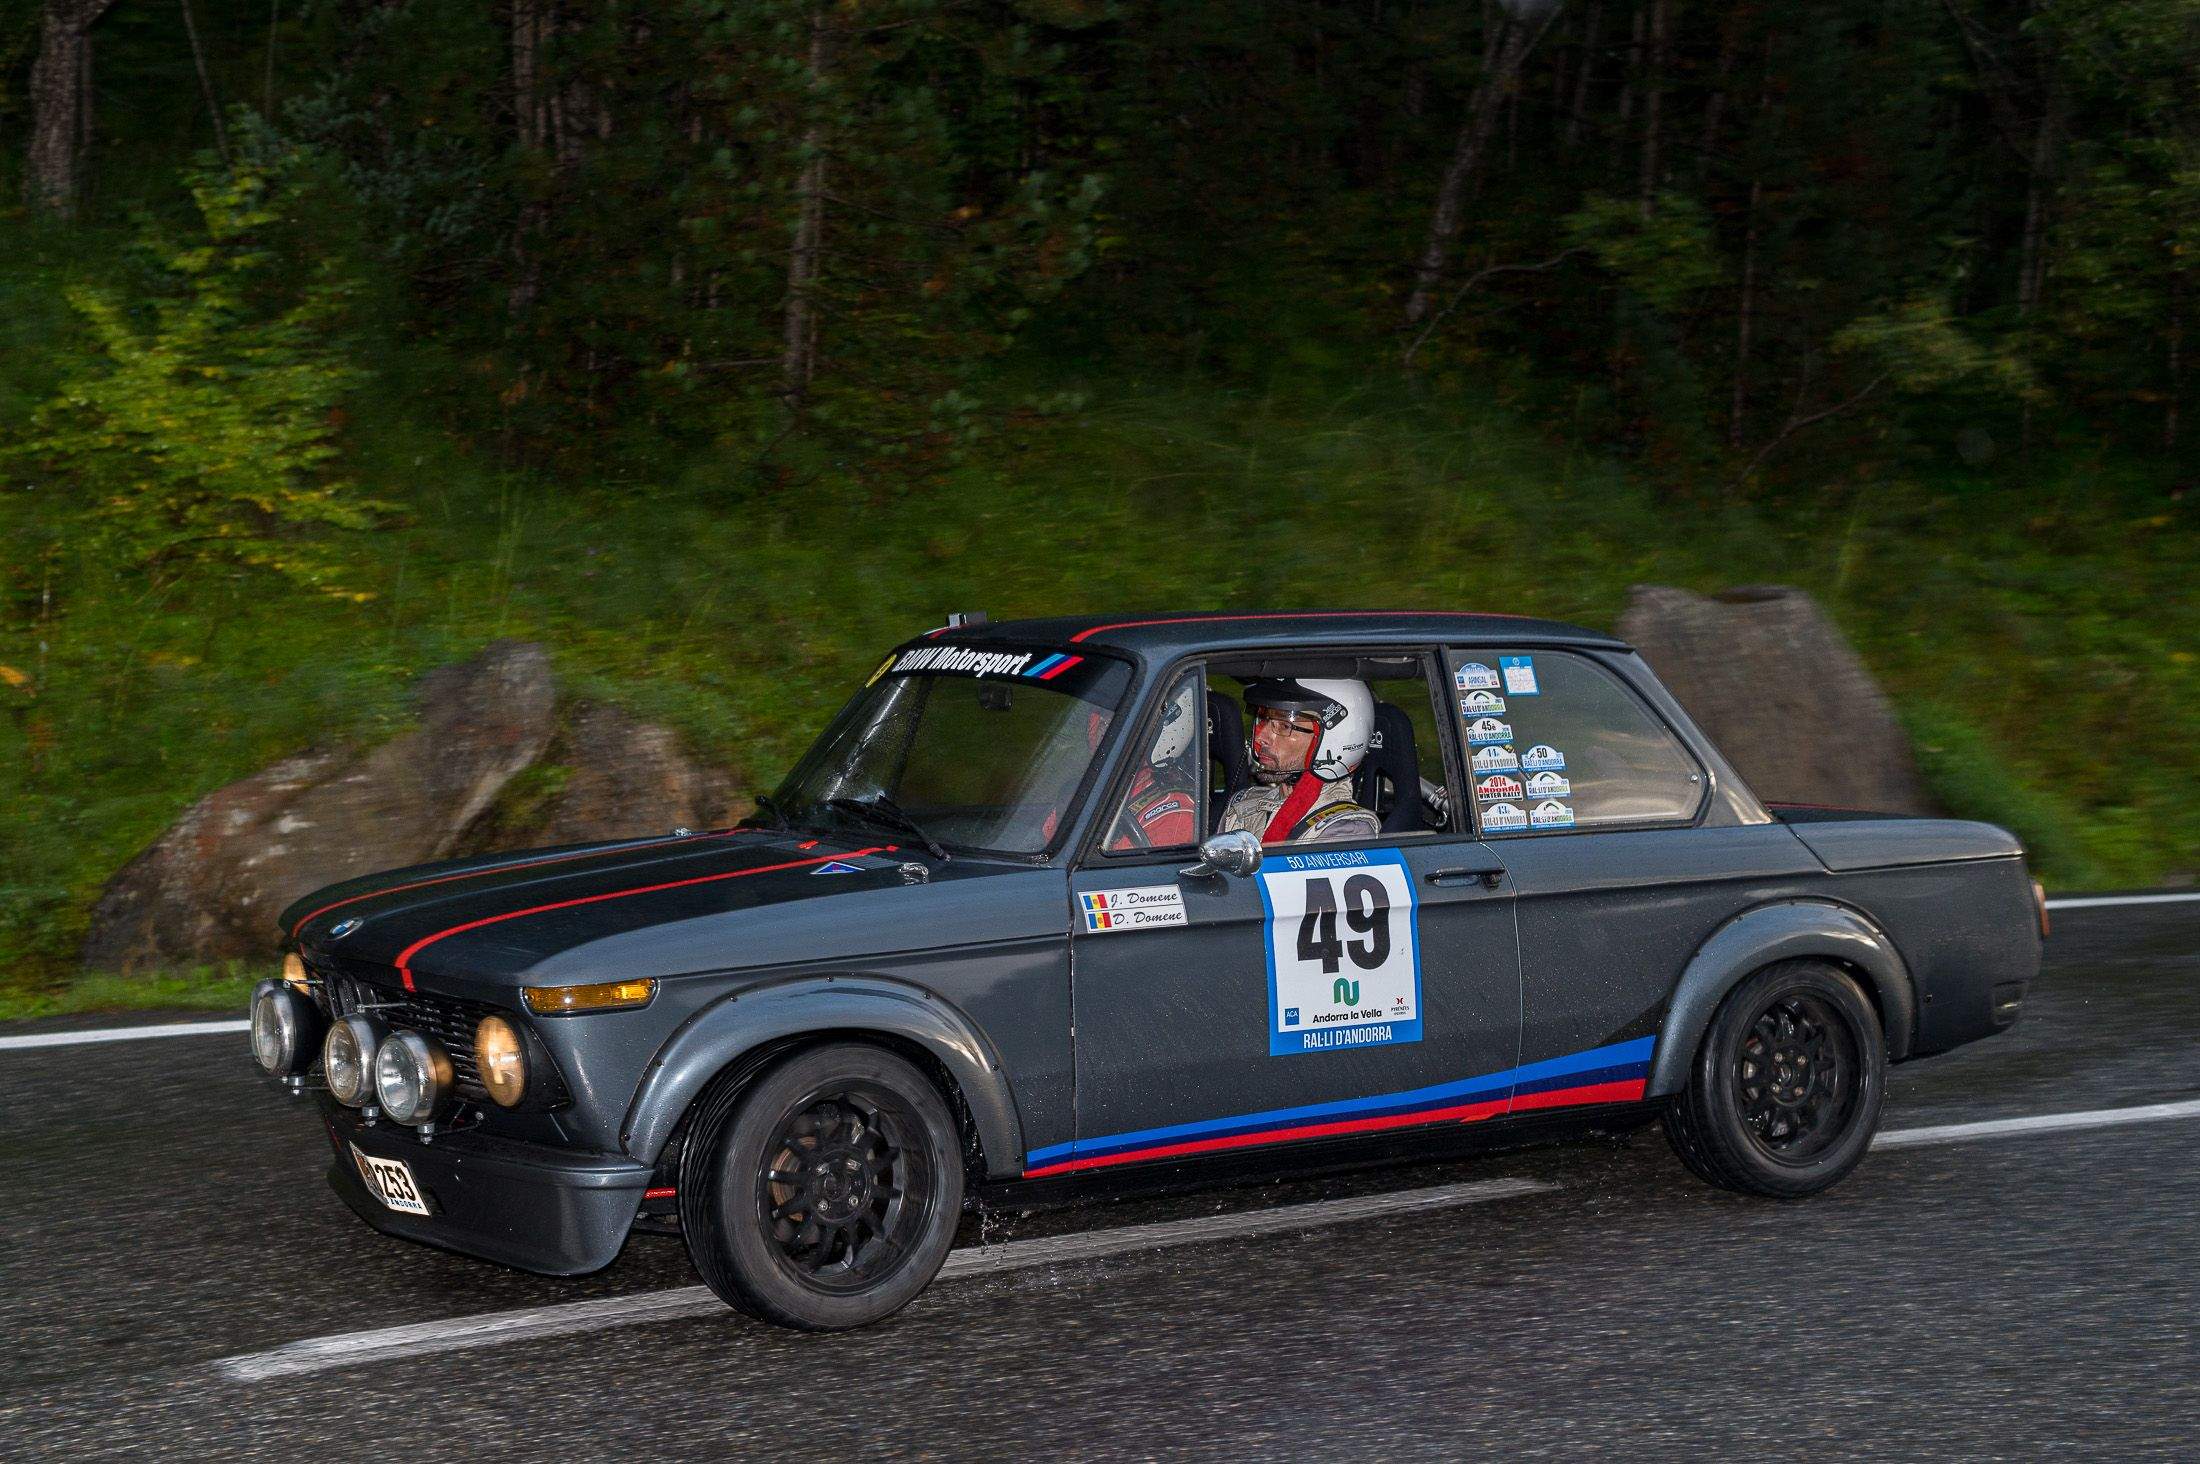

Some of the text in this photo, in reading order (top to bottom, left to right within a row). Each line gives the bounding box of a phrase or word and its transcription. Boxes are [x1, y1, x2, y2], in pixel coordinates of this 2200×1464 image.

[892, 646, 1032, 678] BMW Motorsport
[1536, 747, 1548, 759] 50
[1478, 784, 1520, 794] ANDORRA
[1489, 776, 1507, 788] 2014
[1287, 851, 1369, 869] 50 ANIVERSARI
[1127, 892, 1178, 904] Domene
[1113, 911, 1183, 925] D. Domene
[1297, 874, 1391, 974] 49
[1312, 1012, 1349, 1024] Andorra
[1350, 1011, 1359, 1020] la
[1360, 1008, 1382, 1019] Vella
[1335, 1025, 1392, 1046] D'ANDORRA
